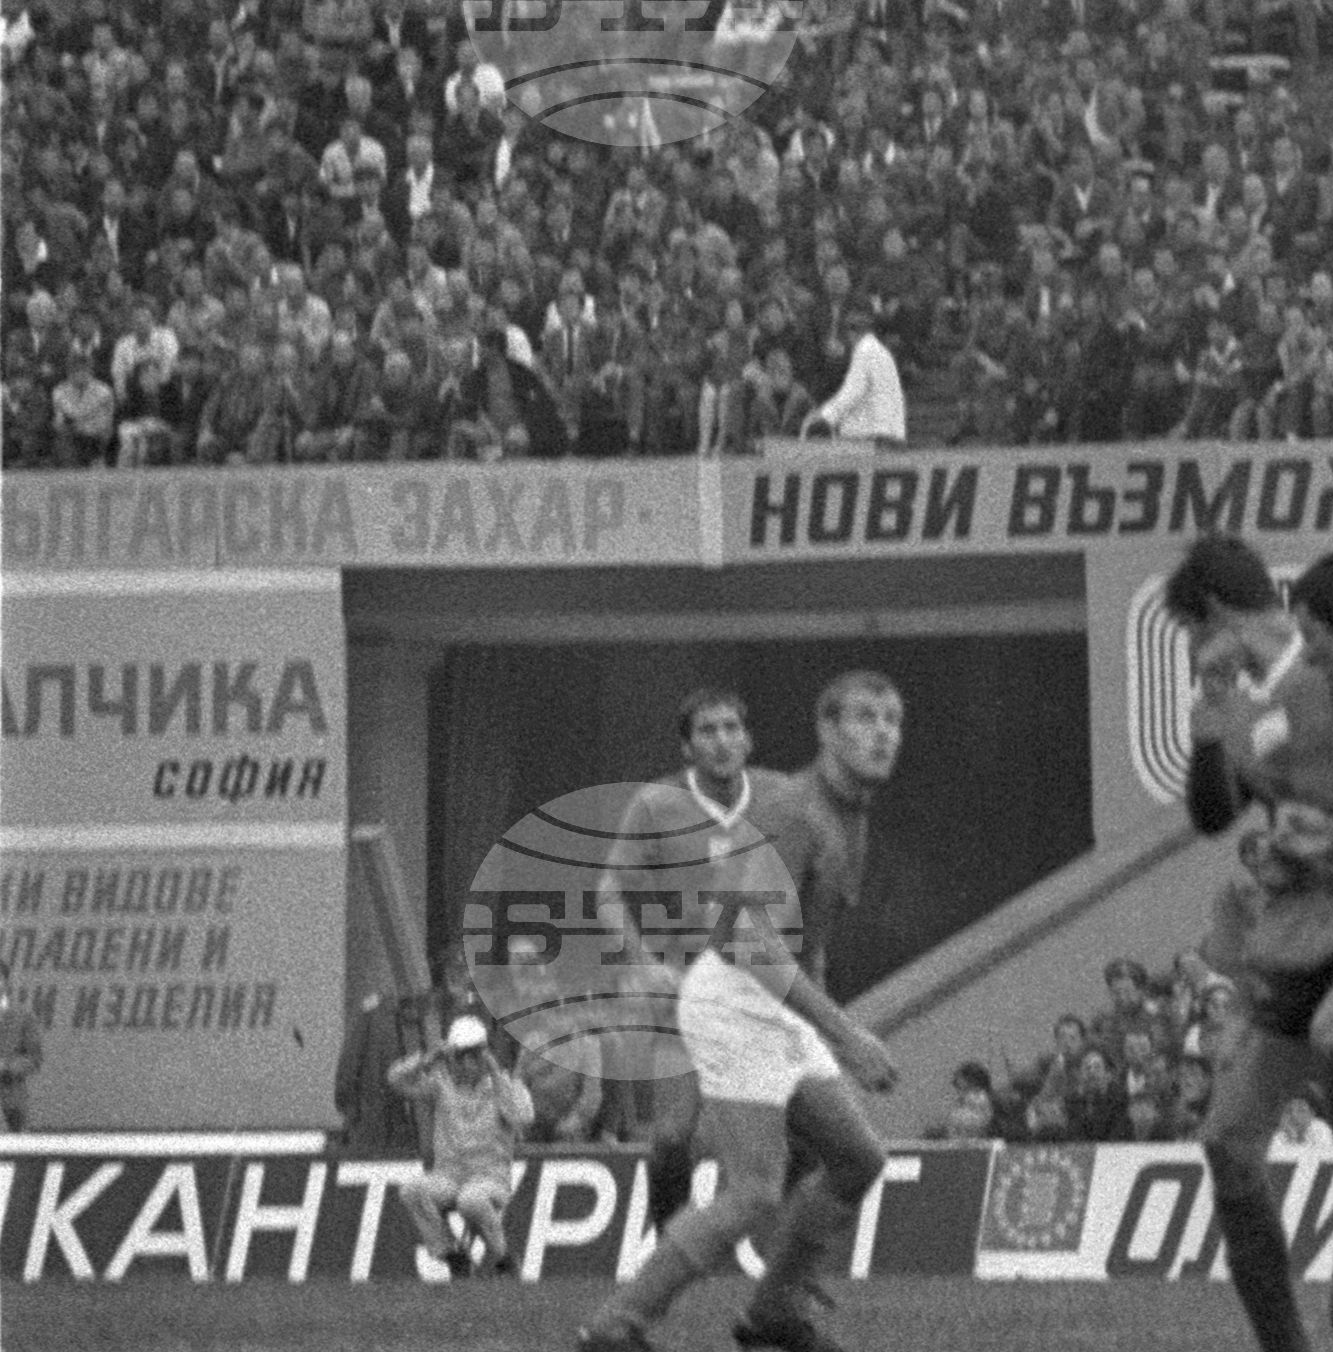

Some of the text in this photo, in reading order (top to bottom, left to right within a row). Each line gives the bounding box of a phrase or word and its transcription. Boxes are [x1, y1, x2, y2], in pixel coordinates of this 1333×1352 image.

[751, 464, 980, 545] НОВИ
[153, 754, 327, 803] СОФИЯ
[60, 866, 242, 914] ВИДОВЕ
[71, 982, 278, 1030] ИЗДЕЛИЯ
